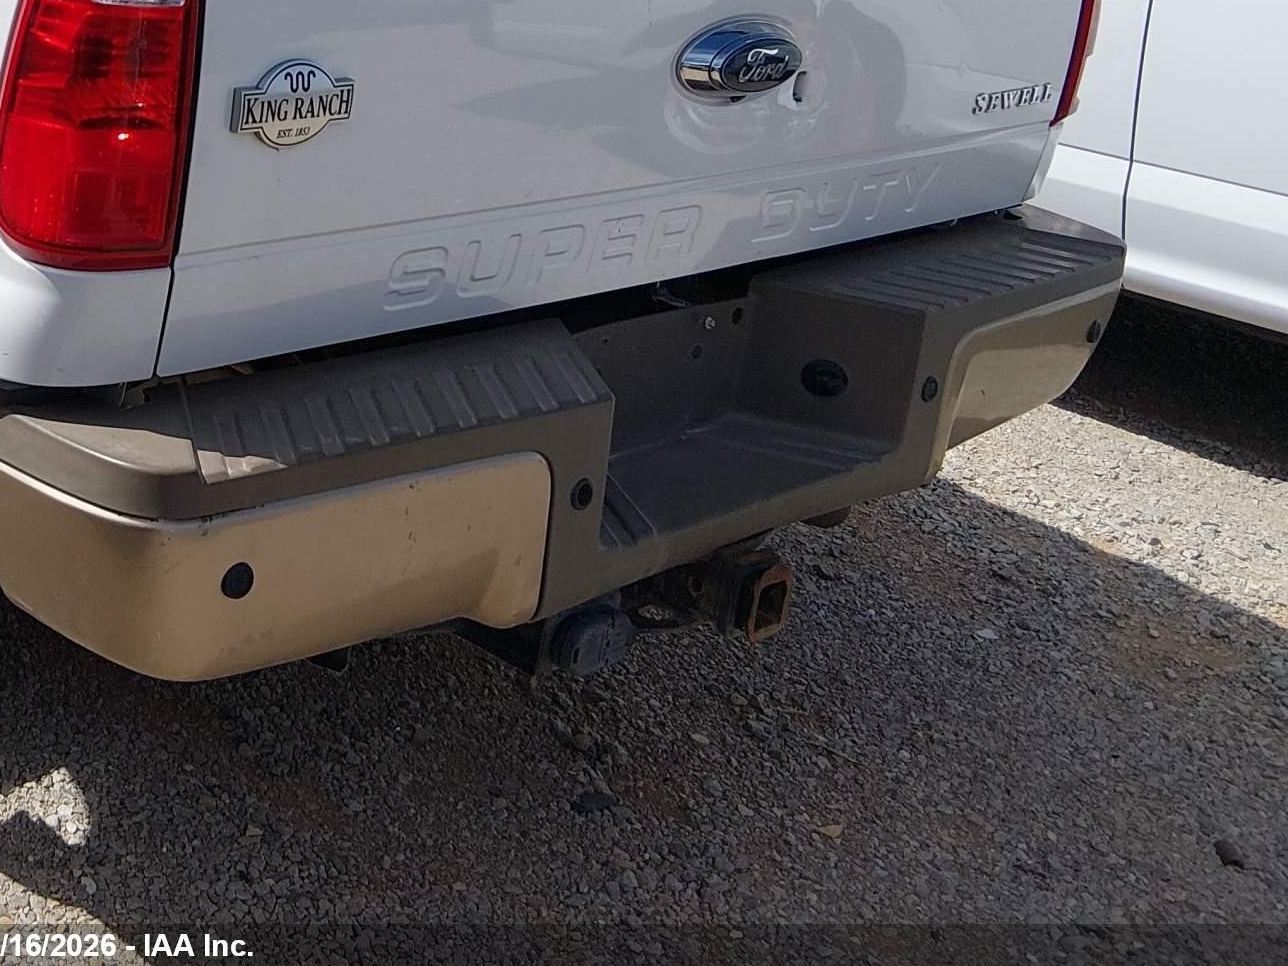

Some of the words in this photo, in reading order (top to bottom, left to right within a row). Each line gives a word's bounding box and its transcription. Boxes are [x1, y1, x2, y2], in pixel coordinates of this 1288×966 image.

[738, 48, 789, 83] Ford
[243, 97, 289, 125] KING
[292, 89, 352, 120] RANCH
[972, 82, 1052, 114] SEWELL
[383, 204, 702, 312] SUPER
[750, 163, 942, 243] DUTY
